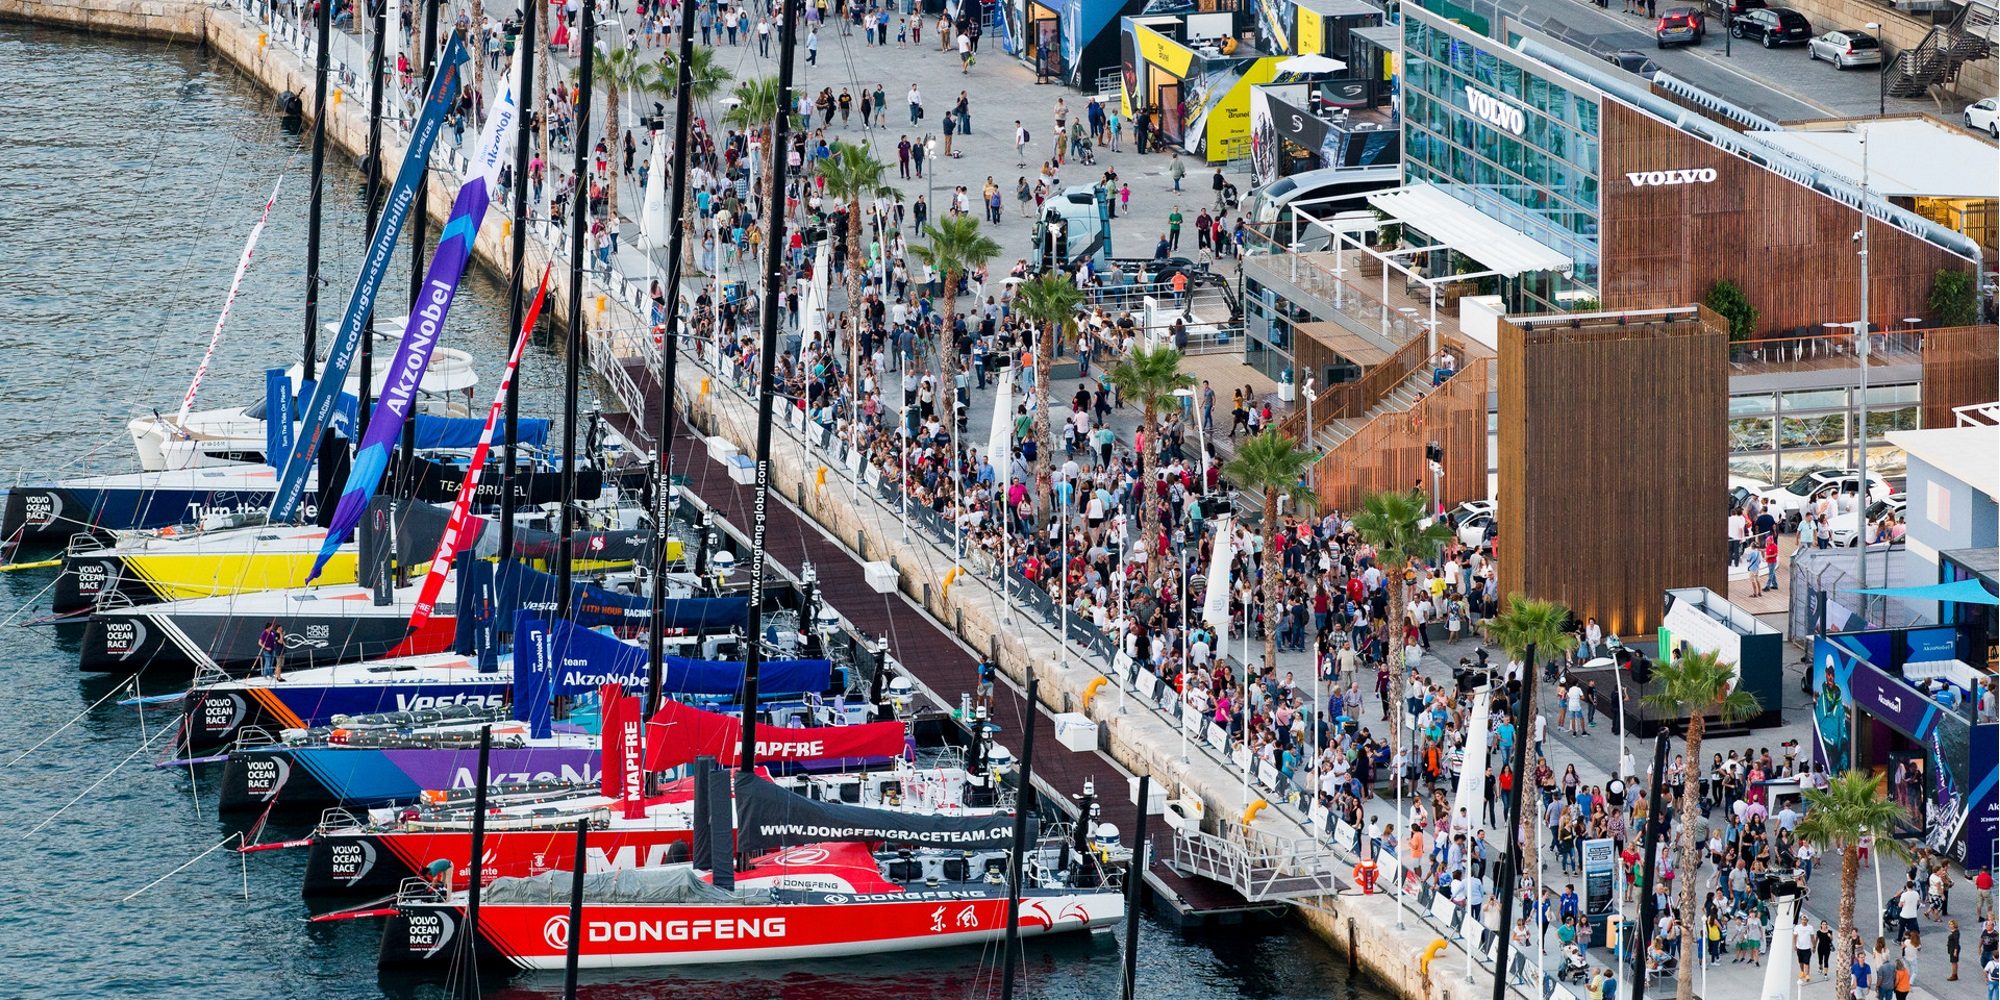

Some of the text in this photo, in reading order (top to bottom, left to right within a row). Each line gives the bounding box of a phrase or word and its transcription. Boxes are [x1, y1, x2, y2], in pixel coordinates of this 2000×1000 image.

[1465, 85, 1526, 136] VOLVO
[414, 118, 434, 159] Vestas
[487, 111, 512, 168] AkzoNob
[1626, 168, 1718, 187] VOLVO
[336, 184, 412, 370] #LeadingSustainability
[386, 280, 452, 418] AkzoNobel
[440, 480, 527, 497] TEA BRUEL
[280, 476, 303, 517] Vestas
[26, 504, 50, 512] OCEAN
[657, 474, 667, 539] desafiomapfre
[26, 512, 46, 520] RACE
[751, 460, 767, 607] www.dongfeng-global.com
[79, 574, 104, 582] OCEAN
[522, 602, 558, 610] Vesta
[582, 604, 651, 618] 11TH HOUR RACING
[107, 624, 132, 632] VOLVO
[108, 640, 127, 648] RACE
[563, 658, 588, 666] team
[563, 671, 650, 687] AkzoNobe
[205, 699, 230, 707] VOLVO
[396, 692, 503, 712] Vestas
[206, 708, 232, 716] OCEAN
[248, 762, 274, 770] VOLVO
[624, 721, 640, 802] MAPFRE
[248, 770, 276, 778] OCEAN
[248, 780, 269, 788] RACE
[760, 824, 1013, 842] WWW.DONGFENGRACETEAM.CN
[332, 846, 360, 854] VOLVO
[332, 855, 362, 863] OCEAN
[333, 864, 354, 872] RACE
[459, 868, 498, 876] alinte
[784, 880, 838, 889] DONGFENG
[854, 890, 986, 902] DONGFENG
[409, 916, 438, 925] VOLVO
[410, 926, 440, 934] OCEAN
[589, 918, 786, 942] DONGFENG
[410, 936, 432, 944] RACE
